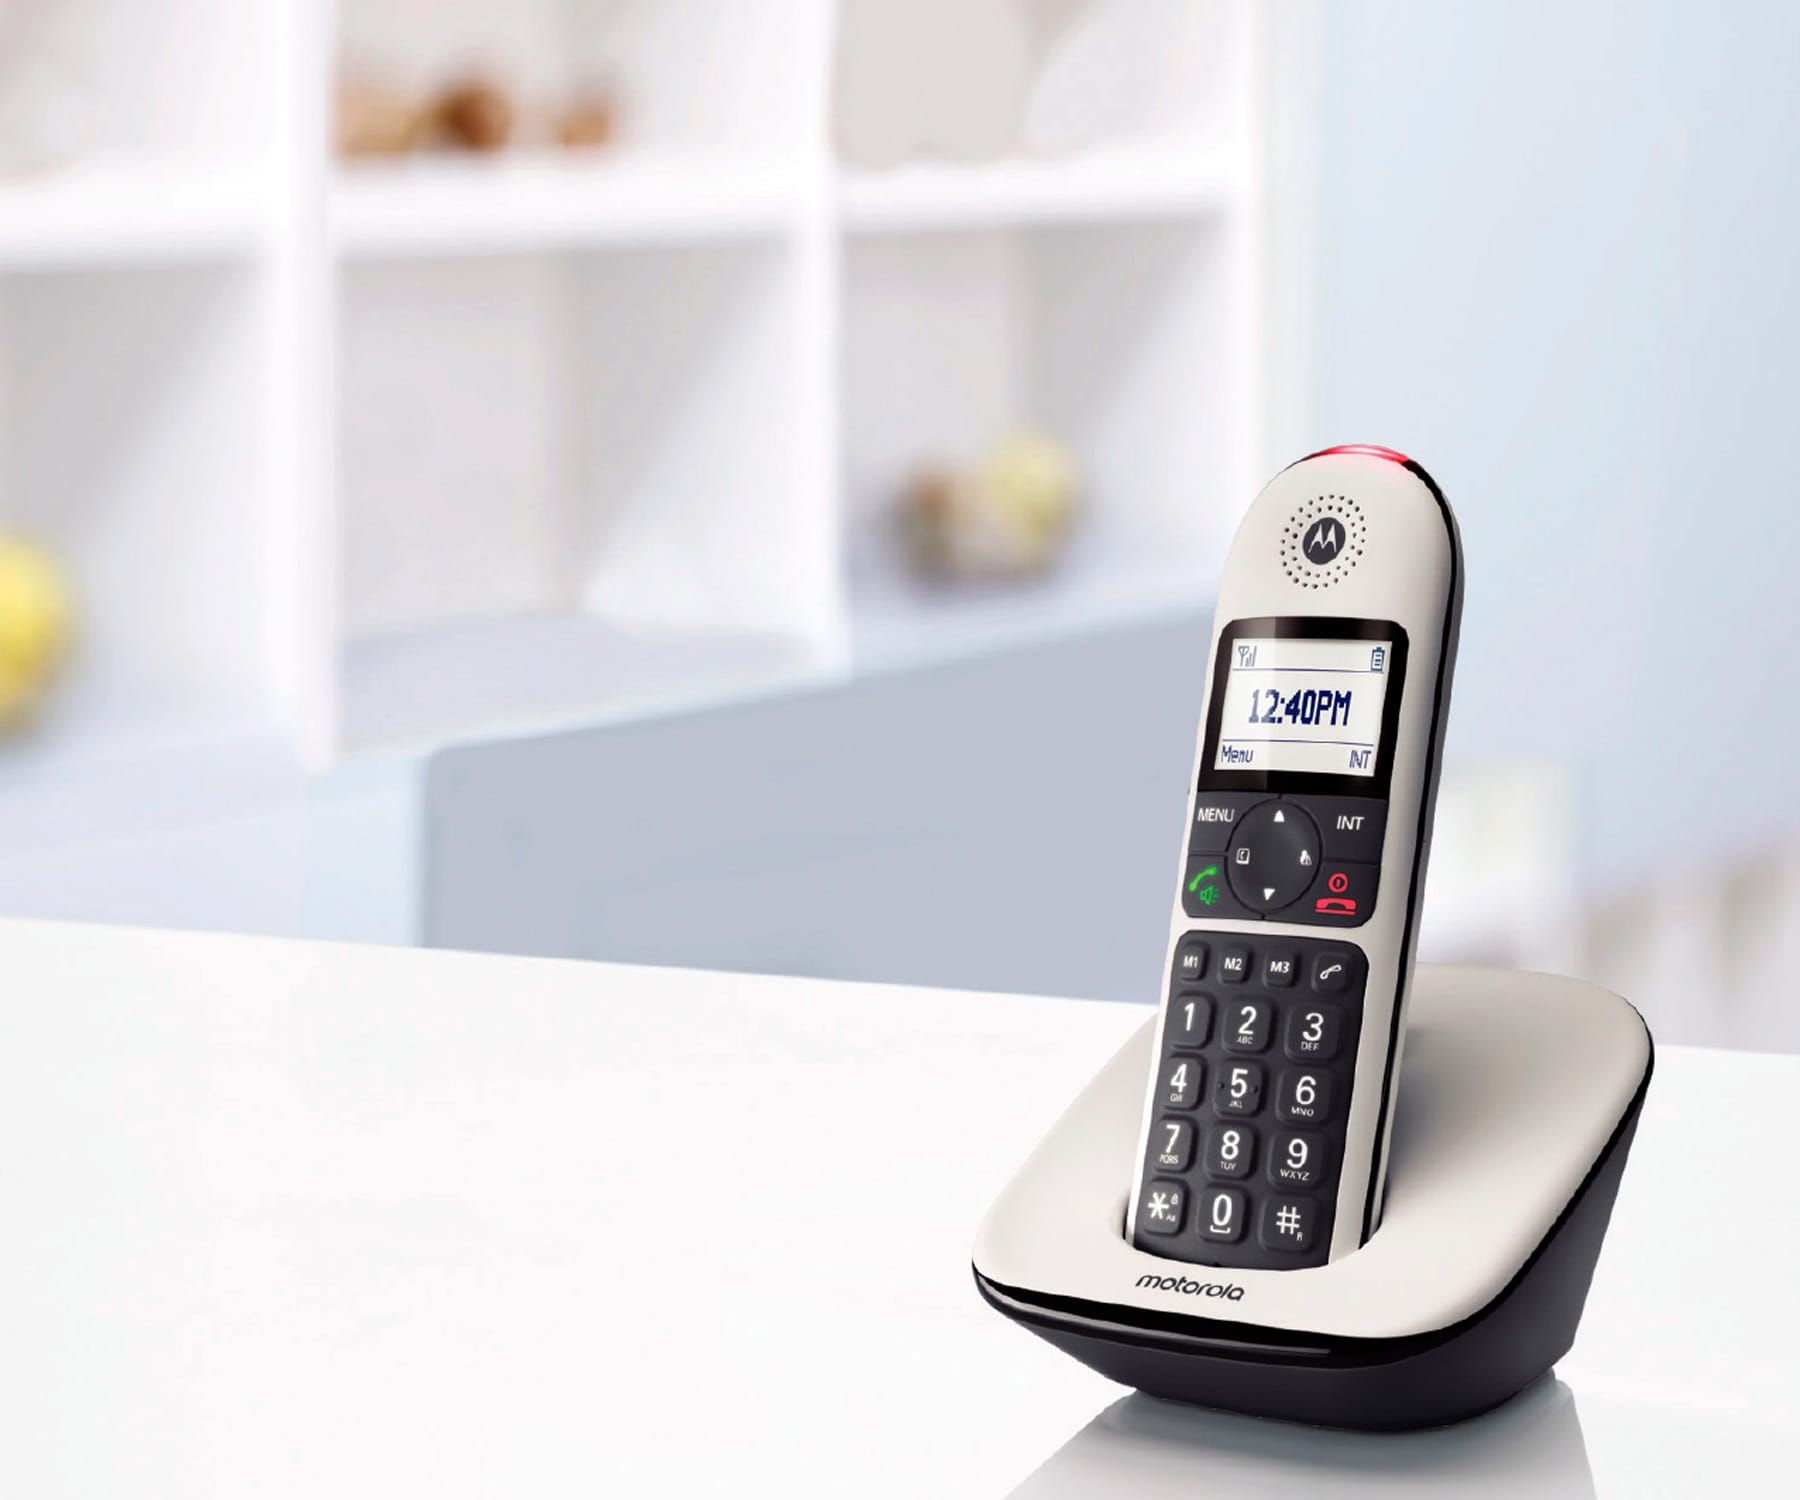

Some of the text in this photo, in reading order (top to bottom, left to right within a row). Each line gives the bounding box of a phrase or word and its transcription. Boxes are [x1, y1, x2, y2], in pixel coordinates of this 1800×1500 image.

[1249, 689, 1352, 726] 12:40PM
[1221, 745, 1254, 763] Menu
[1350, 750, 1372, 769] INT
[1198, 808, 1235, 822] MENU
[1336, 815, 1365, 830] INT
[1183, 956, 1199, 968] M1
[1224, 958, 1242, 971] M2
[1270, 961, 1290, 974] M3
[1184, 1002, 1195, 1031] 1
[1238, 1006, 1257, 1035] 2
[1302, 1012, 1324, 1041] 3
[1236, 1036, 1253, 1045] ABC
[1301, 1041, 1319, 1051] DEF
[1170, 1063, 1187, 1093] 4
[1230, 1068, 1248, 1098] 5
[1296, 1075, 1317, 1105] 6
[1291, 1106, 1314, 1117] MNO
[1166, 1124, 1181, 1153] 7
[1220, 1130, 1240, 1160] 8
[1220, 1161, 1236, 1171] TUV
[1287, 1138, 1308, 1168] 9
[1280, 1168, 1310, 1181] WXYZ
[1212, 1194, 1232, 1226] 0
[1276, 1205, 1301, 1235] #
[1135, 1274, 1245, 1302] motorola
